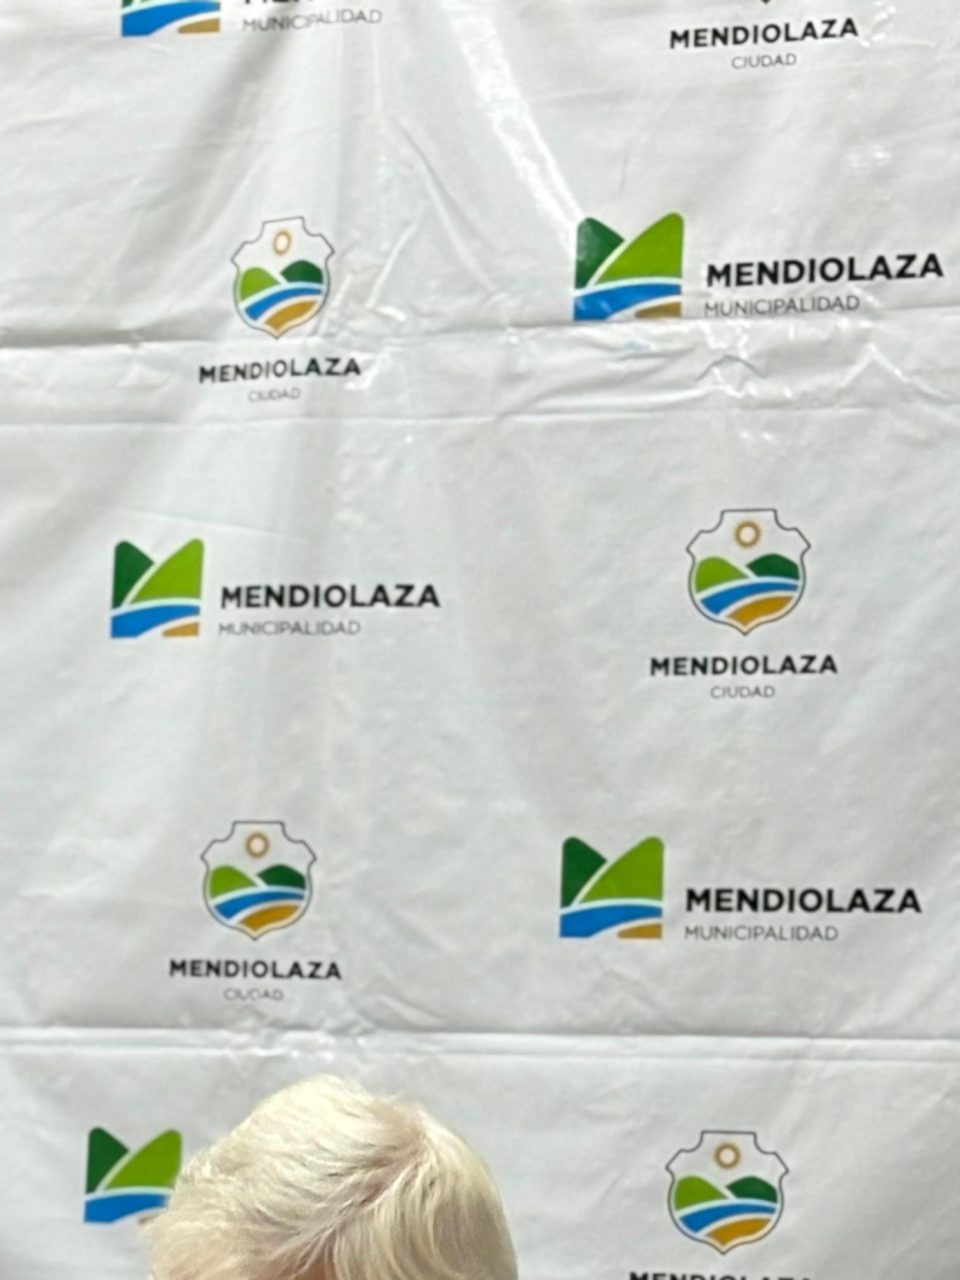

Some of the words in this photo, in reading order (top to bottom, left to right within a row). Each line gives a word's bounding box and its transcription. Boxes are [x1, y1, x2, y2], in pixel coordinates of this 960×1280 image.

[670, 18, 858, 48] MENDIOLAZA
[732, 53, 796, 69] CIUDAD
[707, 253, 943, 287] MENDIOLAZA
[704, 295, 860, 318] MUNICIPALIDAD
[199, 358, 361, 383] MENDIOLAZA
[221, 584, 440, 608] MENDIOLAZA
[219, 621, 360, 635] MUNICIPALIDAD
[651, 655, 837, 675] MENDIOLAZA
[710, 685, 775, 699] CIUDAD
[686, 888, 921, 913] MENDIOLAZA
[685, 925, 838, 941] MUNICIPALIDAD
[170, 960, 341, 979] MENDIOLAZA
